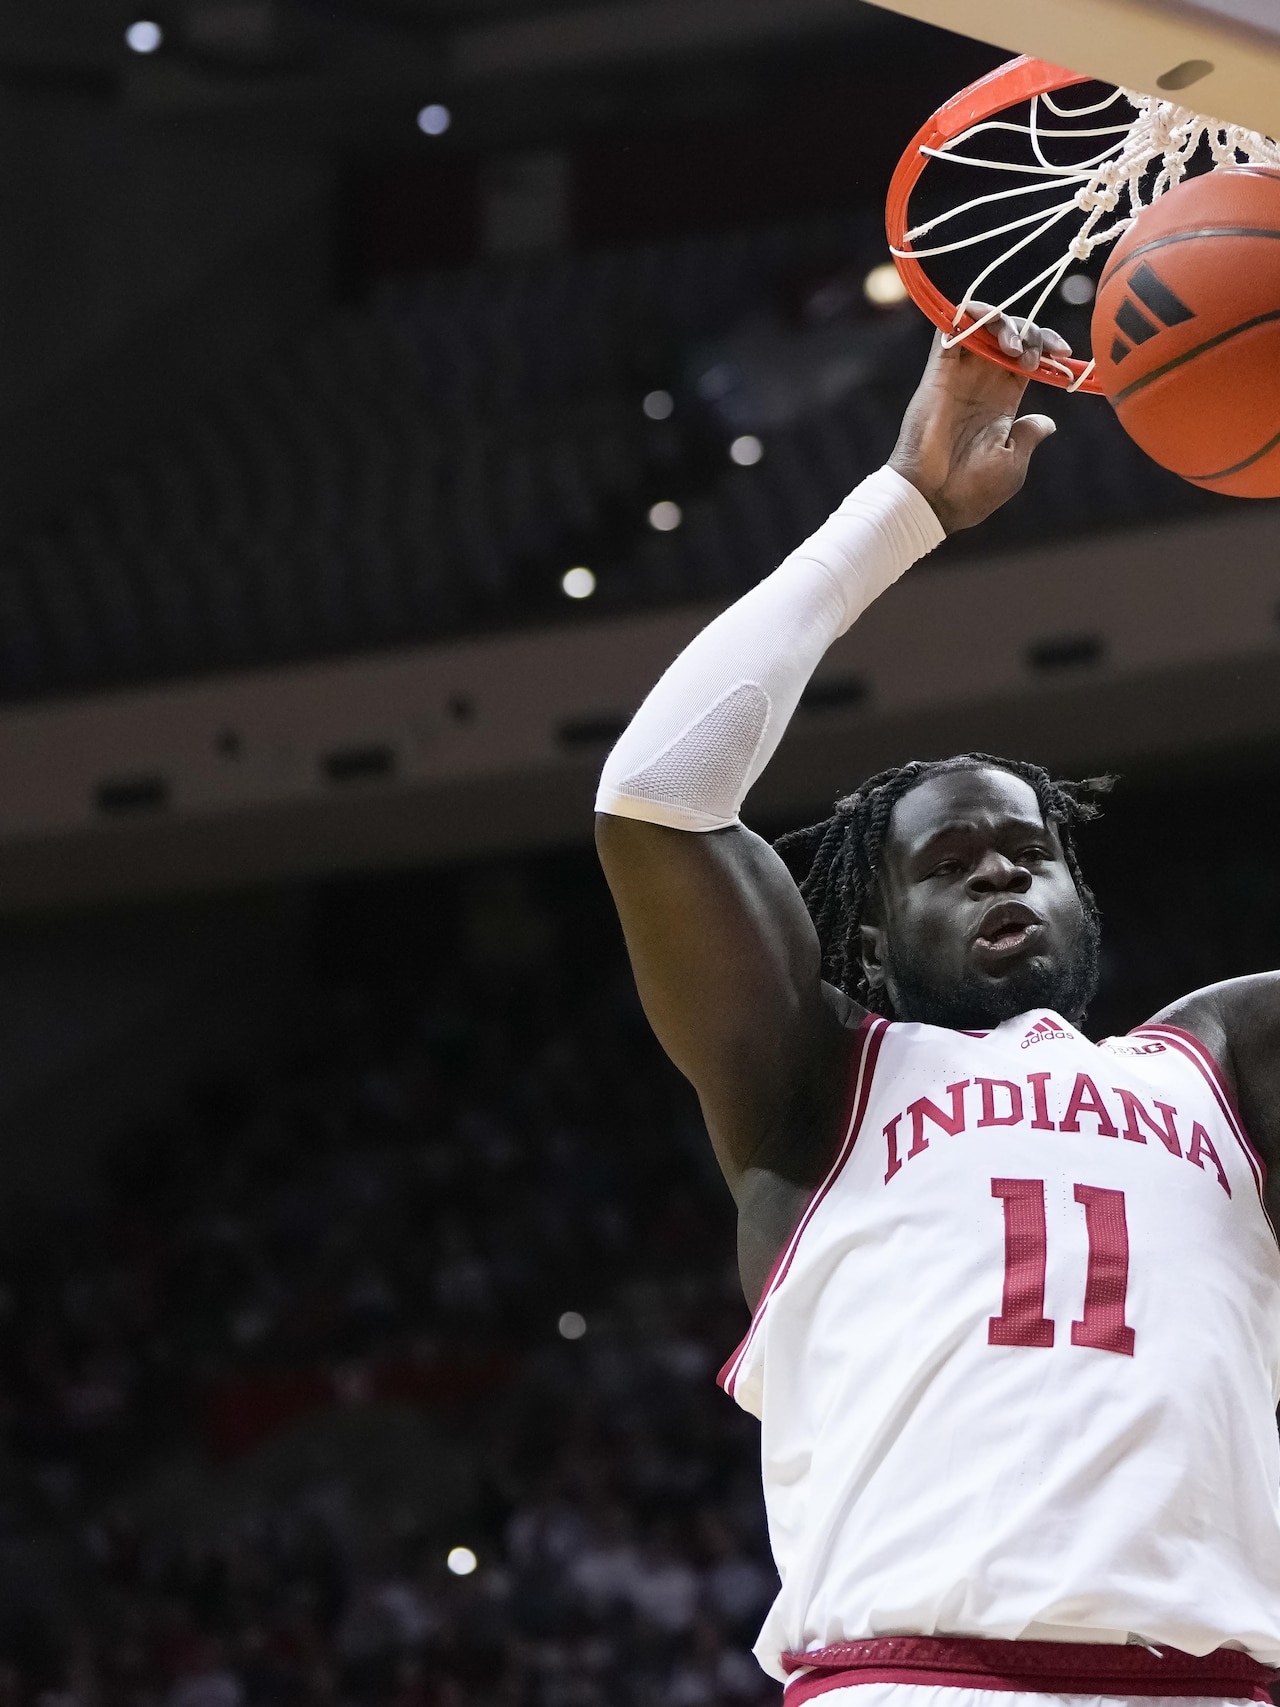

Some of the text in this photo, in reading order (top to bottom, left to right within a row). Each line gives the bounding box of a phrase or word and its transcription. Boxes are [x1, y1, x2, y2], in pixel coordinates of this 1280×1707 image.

[1020, 1030, 1074, 1049] adidas
[882, 1072, 1232, 1200] INDIANA
[988, 1177, 1135, 1356] 11
